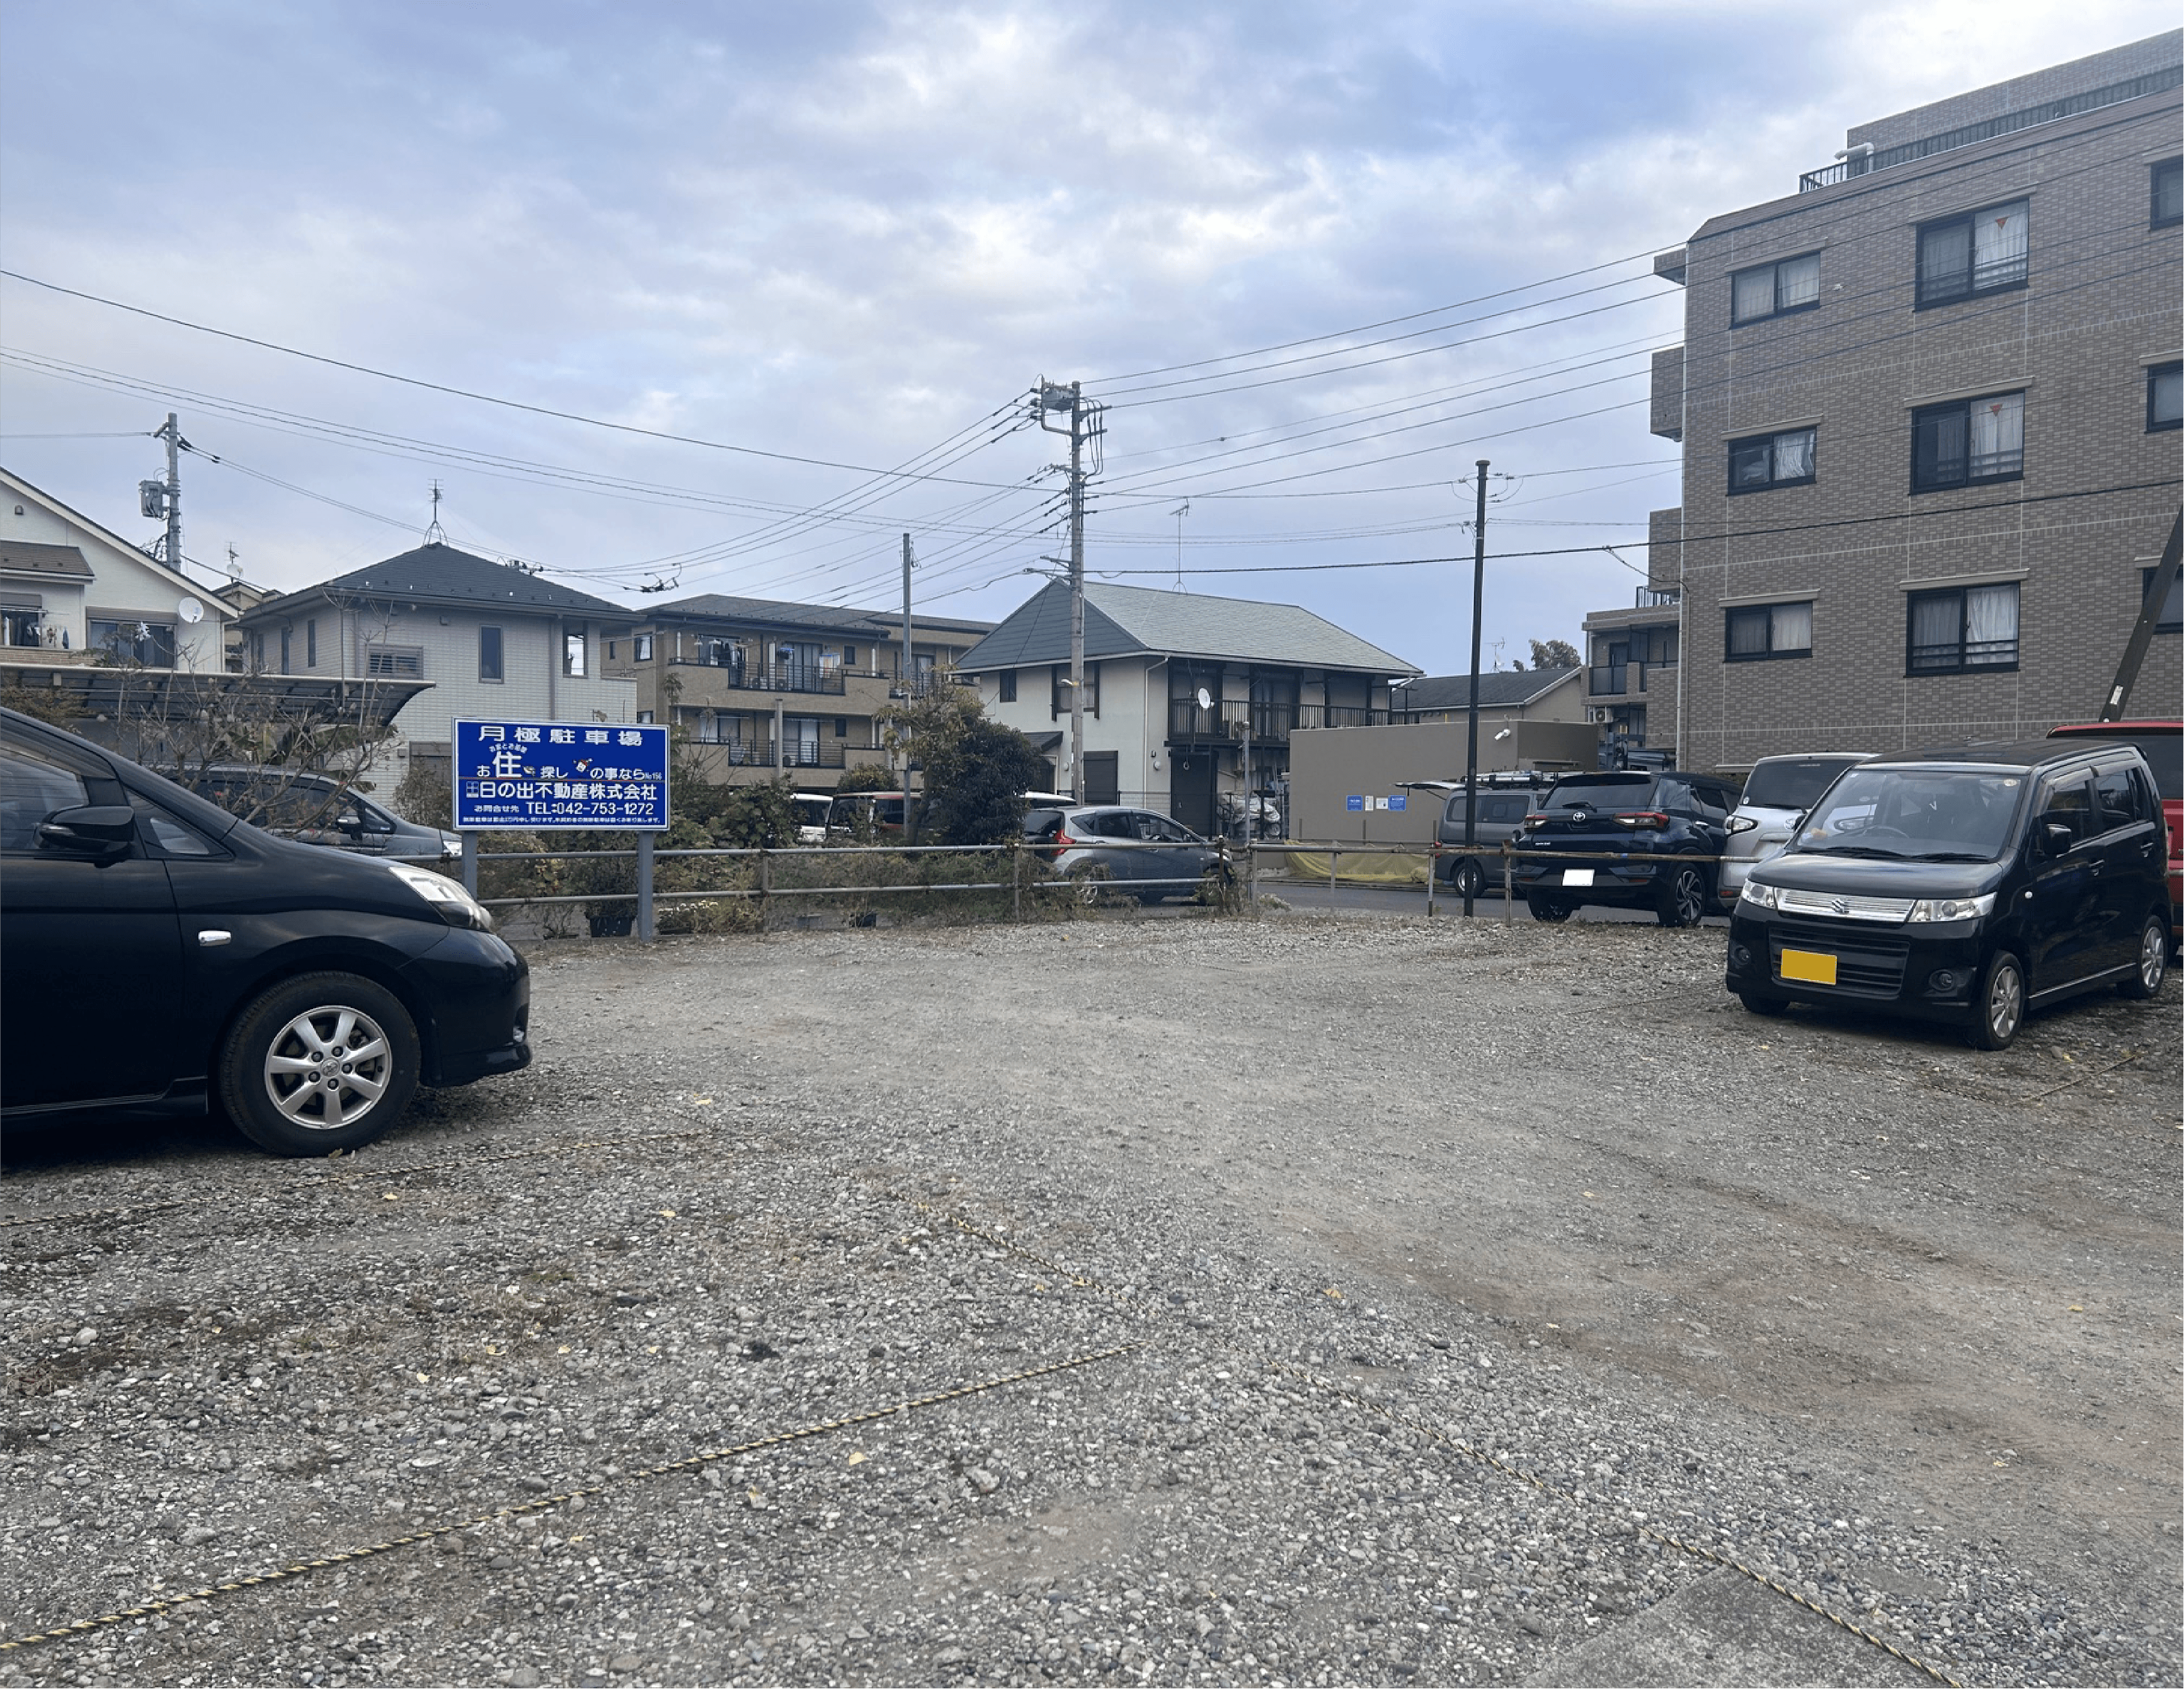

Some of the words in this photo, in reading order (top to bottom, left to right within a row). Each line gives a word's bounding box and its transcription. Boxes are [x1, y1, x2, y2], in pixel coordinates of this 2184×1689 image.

[479, 726, 643, 746] 月極駐車場
